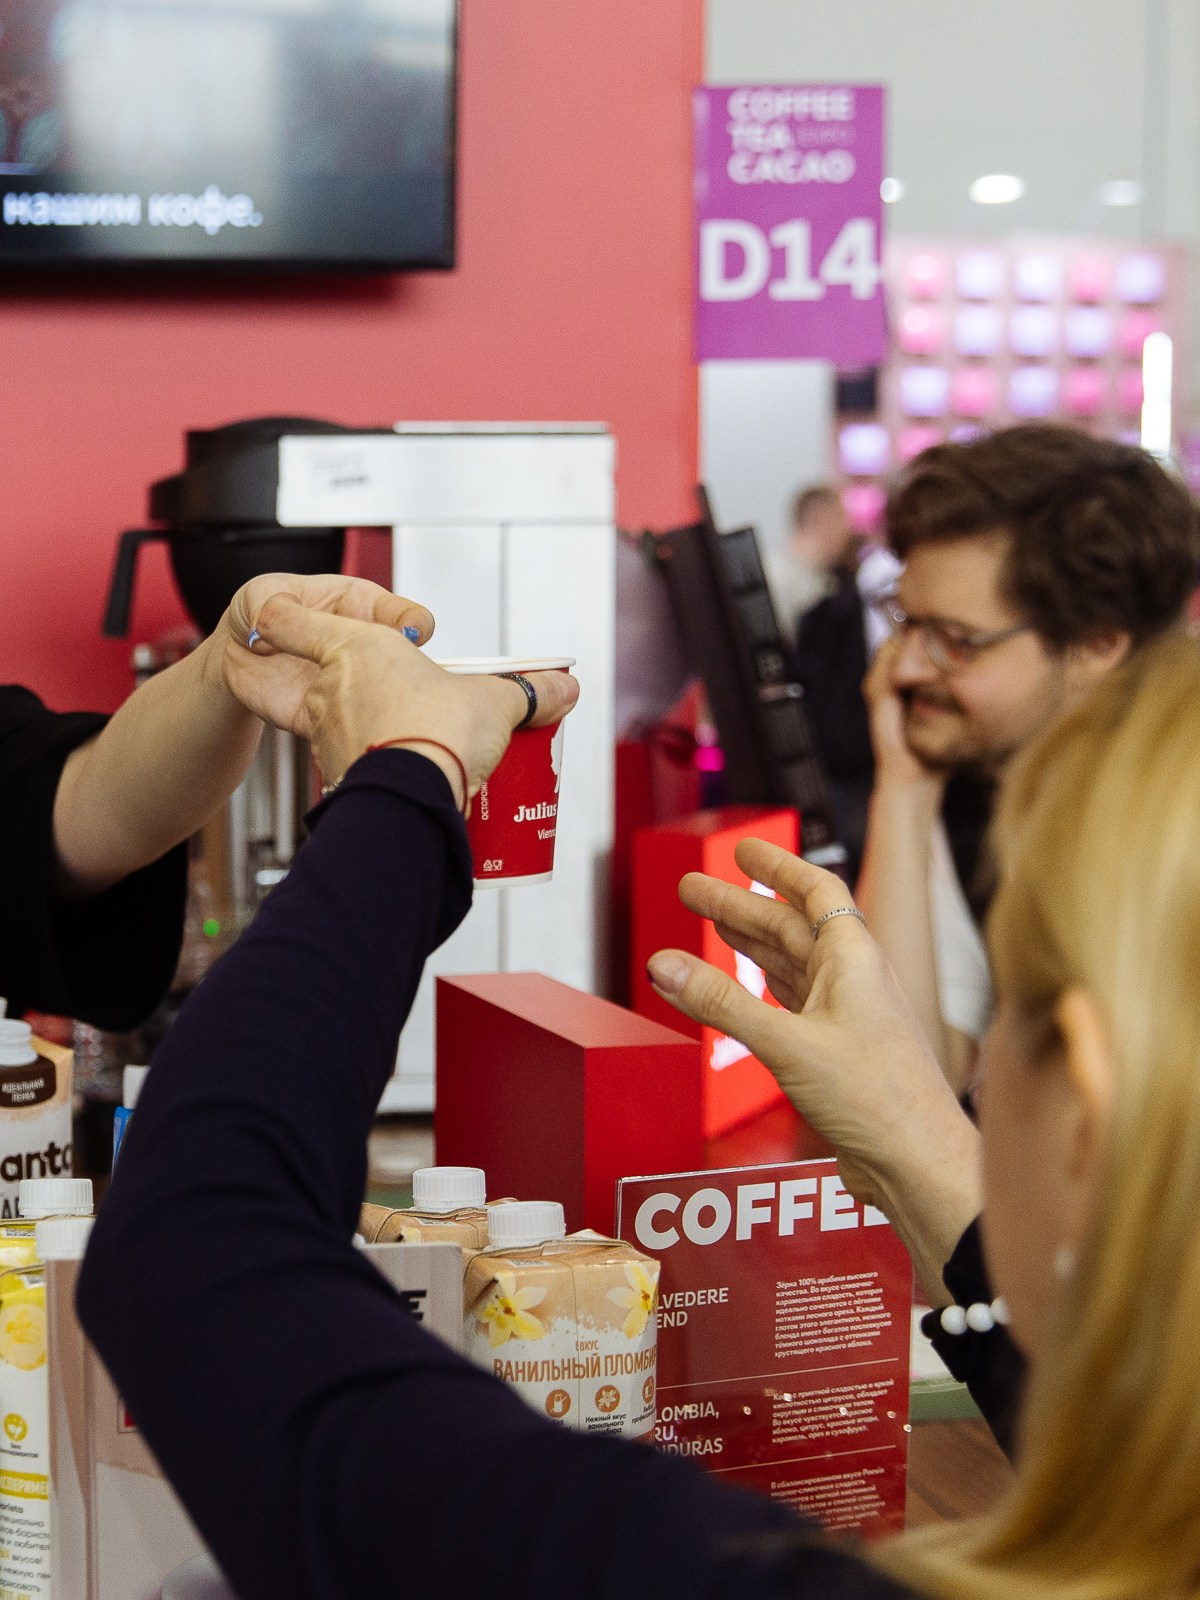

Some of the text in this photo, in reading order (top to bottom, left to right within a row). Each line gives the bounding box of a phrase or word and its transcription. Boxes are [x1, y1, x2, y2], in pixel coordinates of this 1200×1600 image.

[728, 89, 856, 121] COFFEE
[728, 122, 794, 151] TEA
[728, 150, 856, 184] CACAO
[4, 192, 142, 227] нашим
[148, 184, 263, 235] кофе.
[701, 217, 881, 302] D14
[481, 782, 489, 821] ОСТОРОЖ
[513, 802, 557, 823] Julius
[657, 1310, 688, 1329] END
[493, 1353, 601, 1383] ВАНИЛЬНЫЙ
[612, 1413, 627, 1422] вкус
